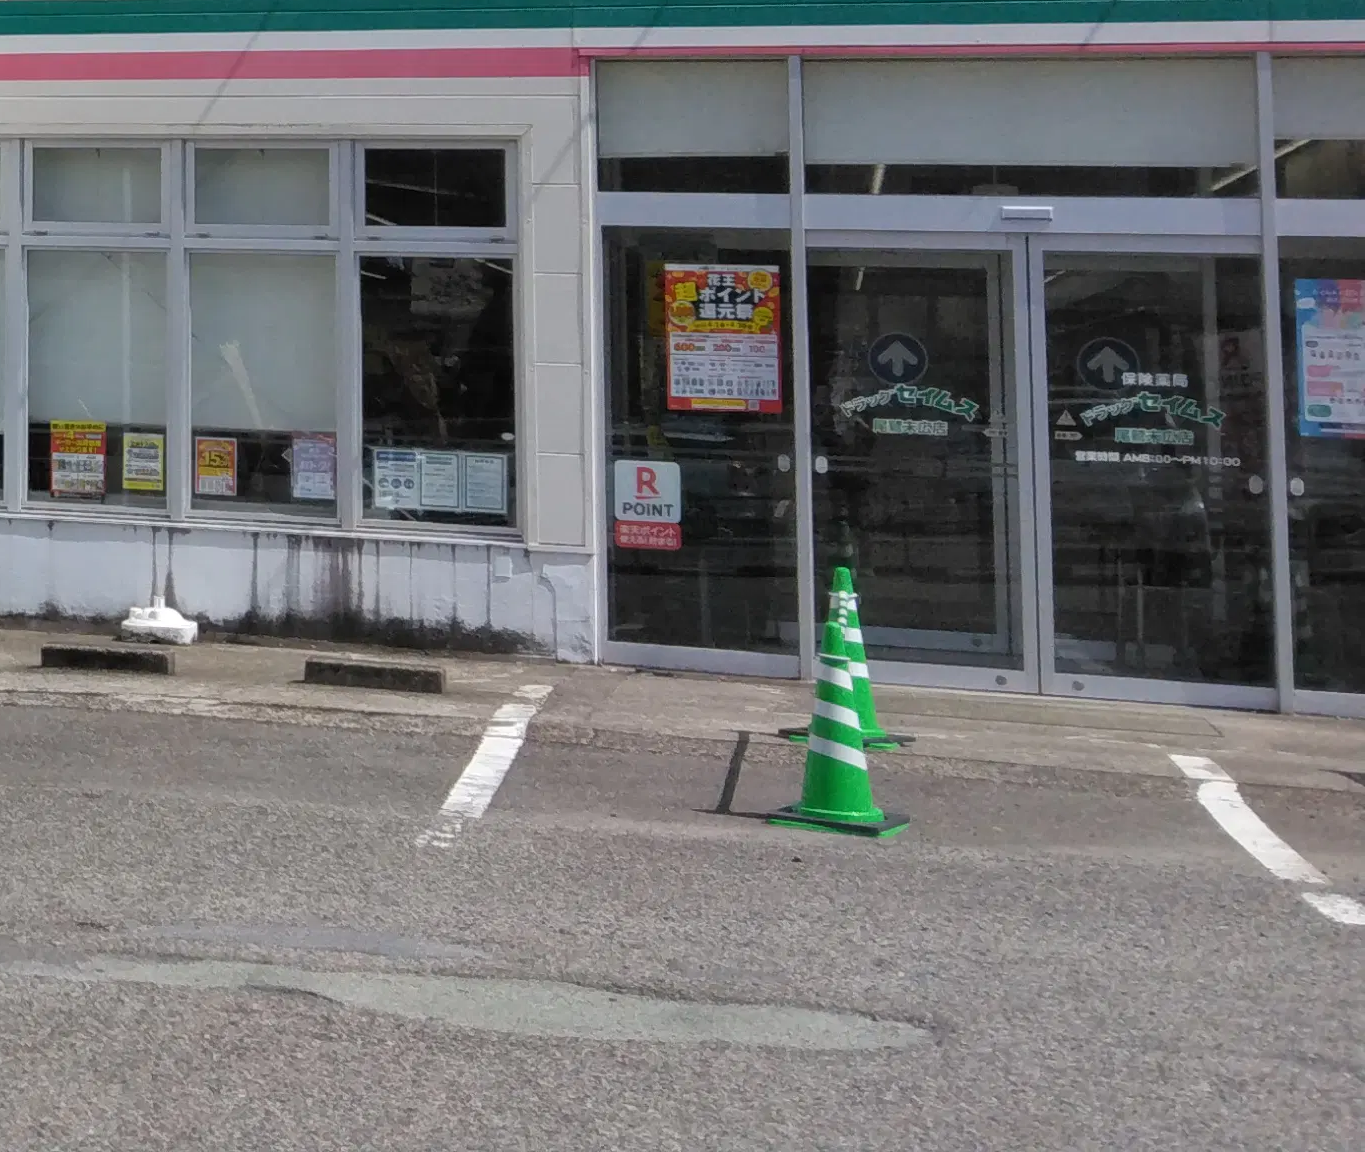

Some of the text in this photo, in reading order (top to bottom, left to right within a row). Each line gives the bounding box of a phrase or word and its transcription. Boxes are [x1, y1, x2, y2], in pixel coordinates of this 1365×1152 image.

[698, 288, 766, 303] ポイント
[636, 466, 660, 495] R
[622, 502, 674, 517] POINT
